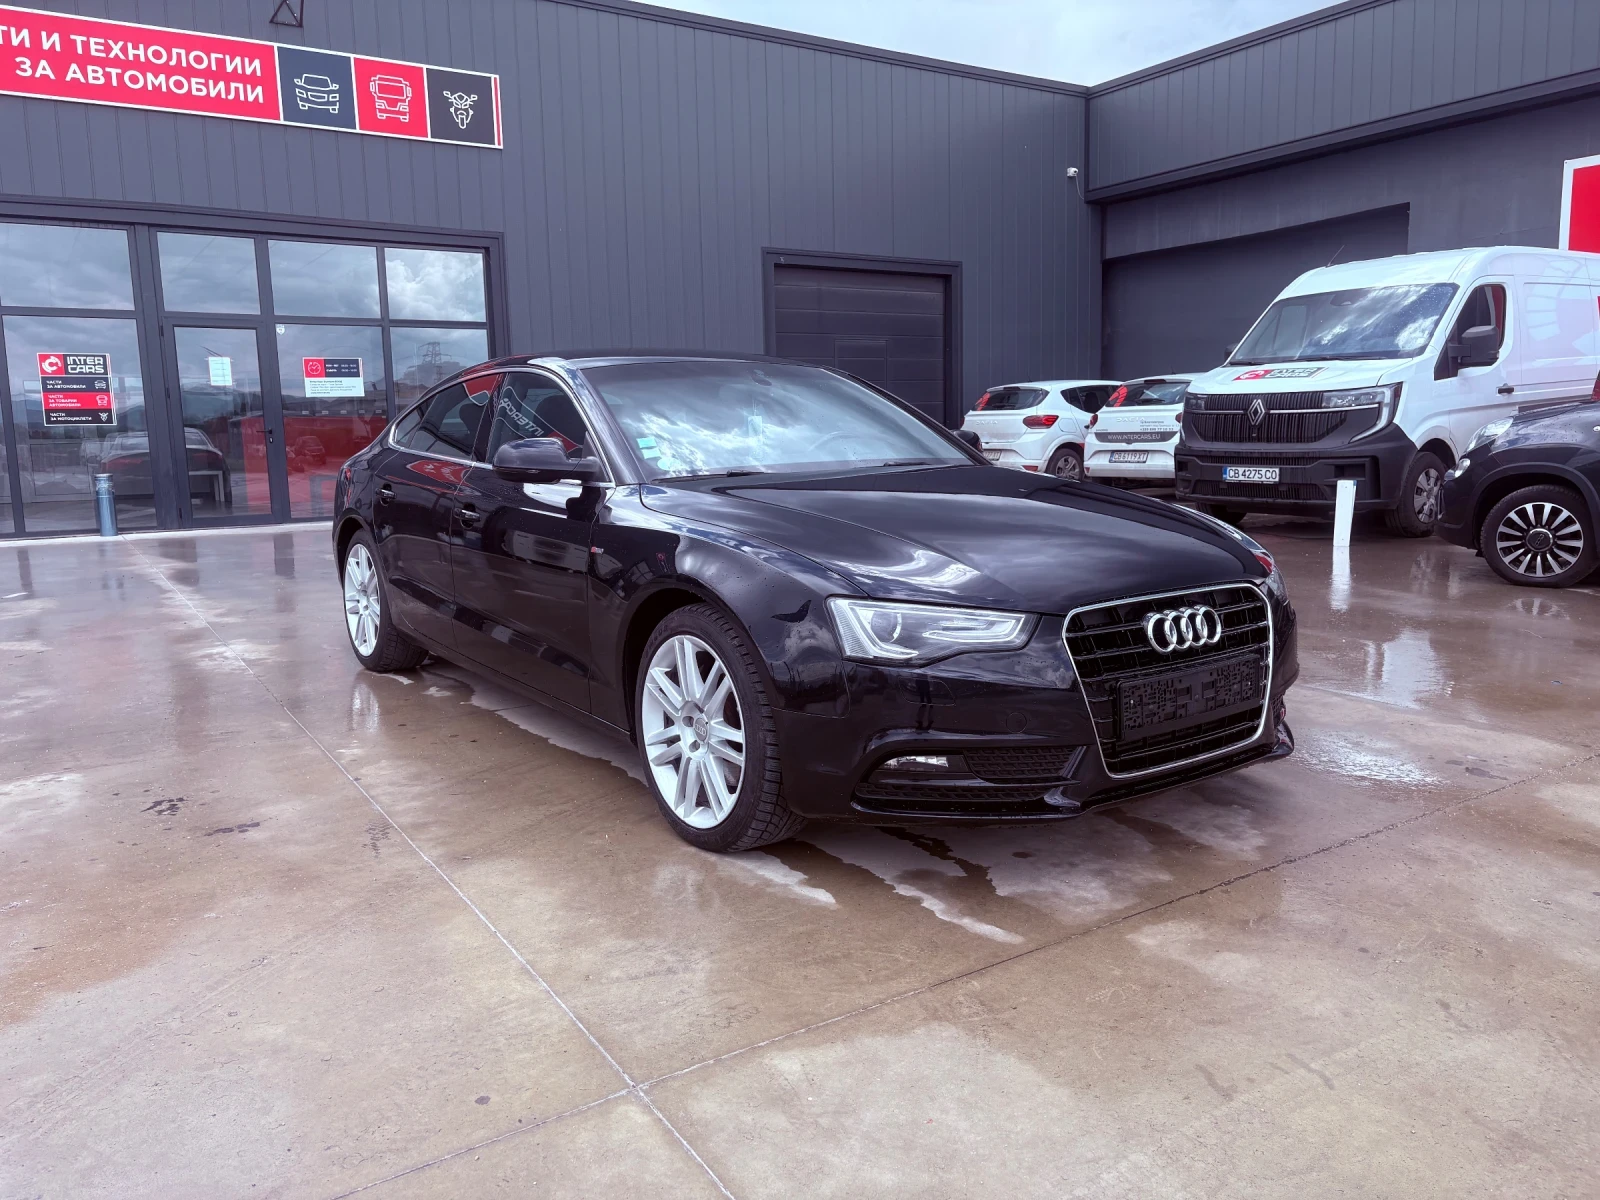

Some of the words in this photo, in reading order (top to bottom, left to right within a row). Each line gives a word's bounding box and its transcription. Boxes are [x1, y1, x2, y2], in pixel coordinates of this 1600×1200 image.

[40, 30, 62, 52] И
[69, 34, 262, 77] ТЕХНОЛОГИИ
[14, 56, 56, 80] ЗА
[65, 62, 264, 103] АВТОМОБИЛИ
[66, 356, 103, 365] INTER
[68, 365, 104, 374] CARS
[1228, 468, 1240, 479] CB
[1241, 469, 1263, 480] 4275
